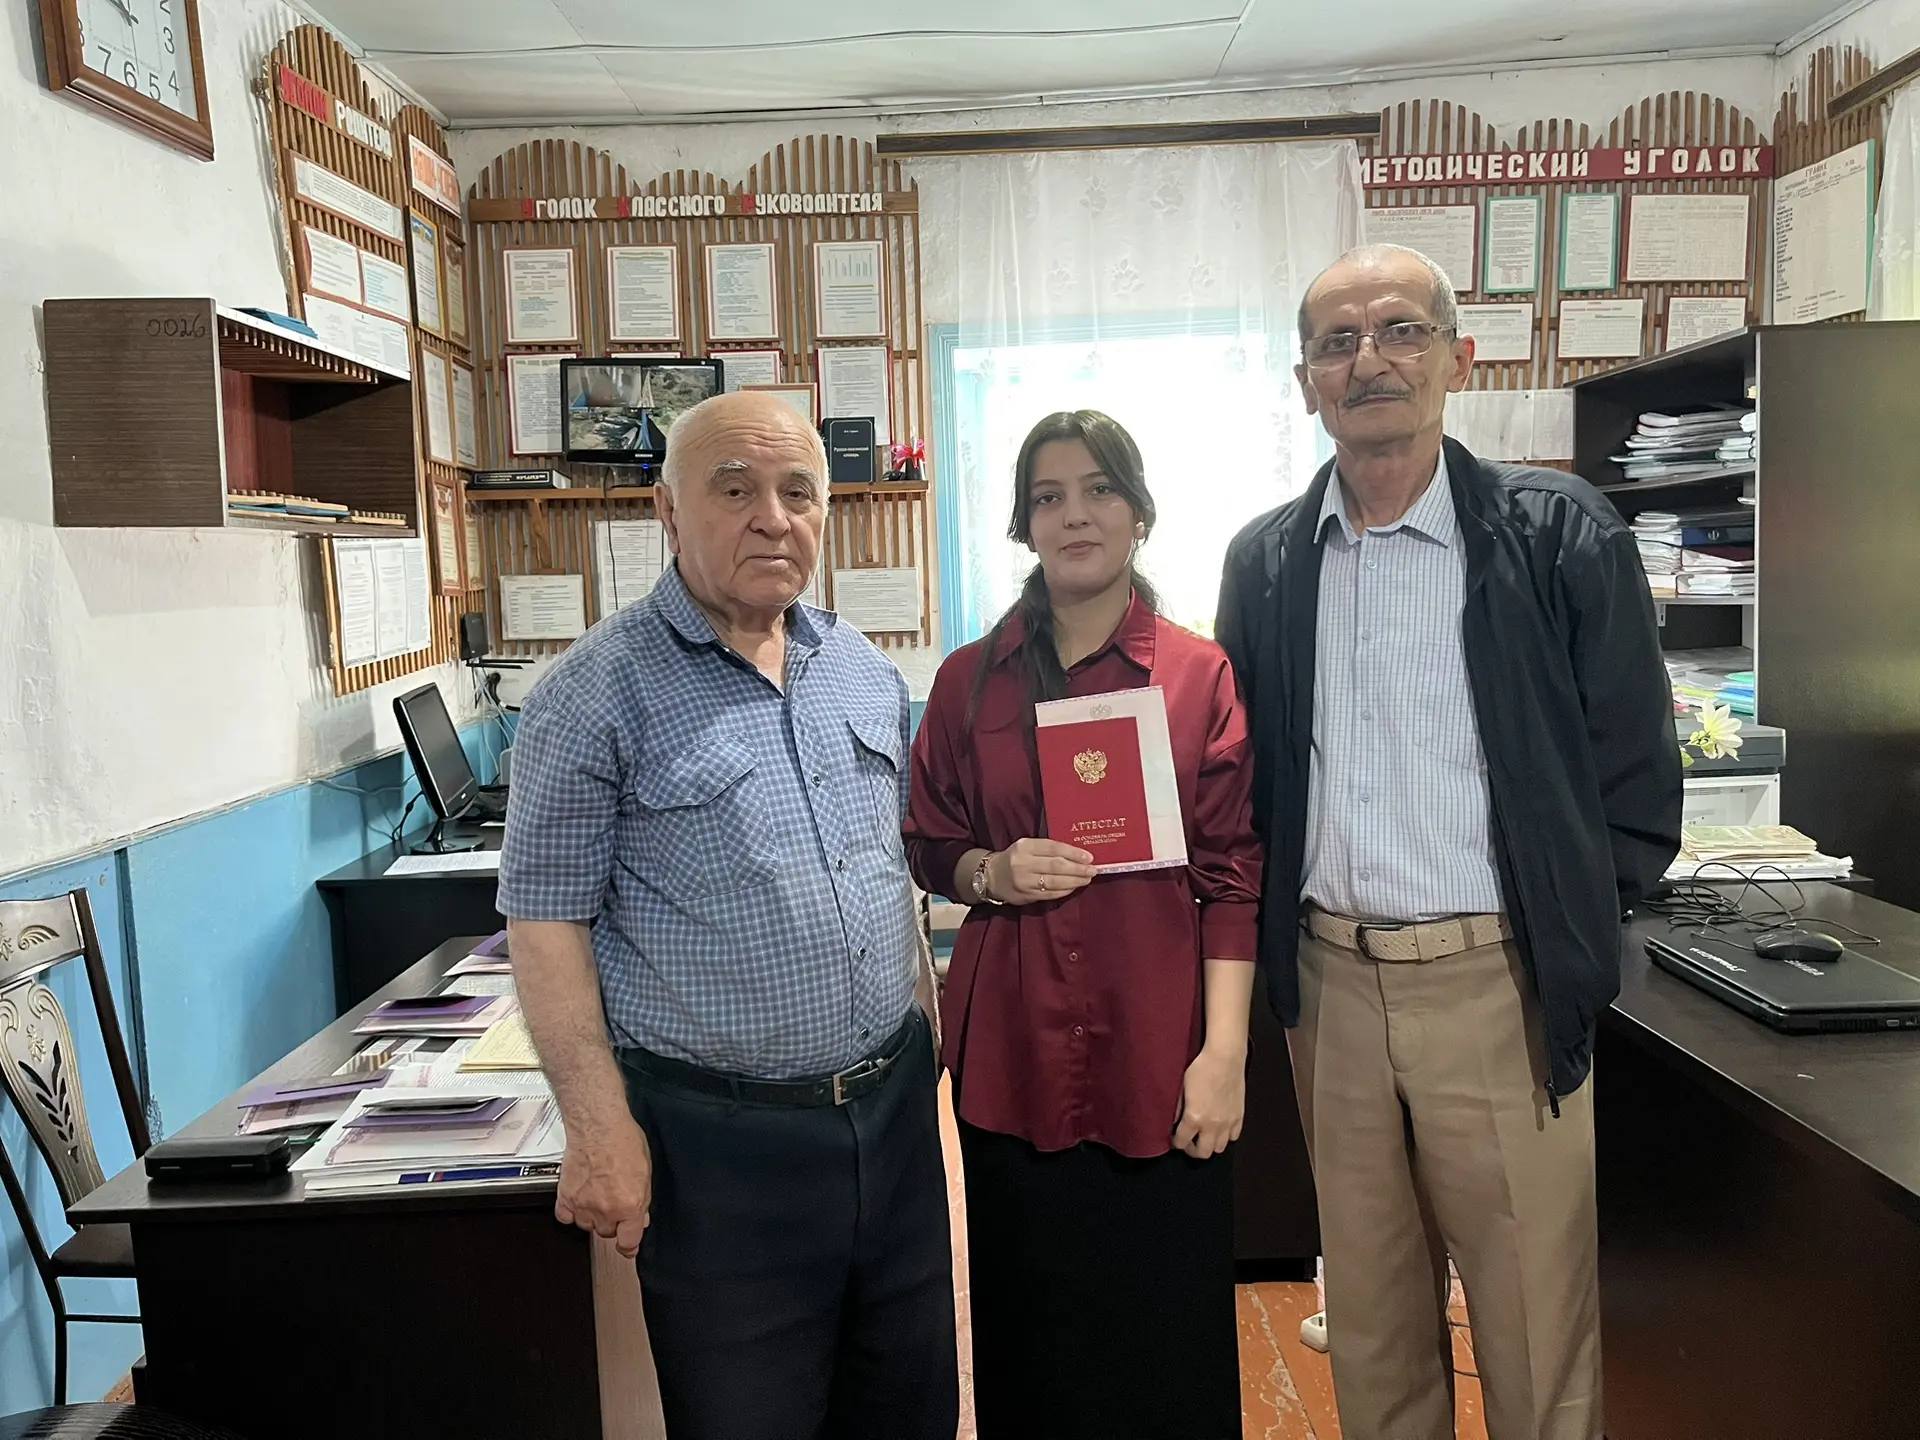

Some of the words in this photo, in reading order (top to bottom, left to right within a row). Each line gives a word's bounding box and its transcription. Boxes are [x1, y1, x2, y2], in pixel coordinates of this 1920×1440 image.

[163, 26, 175, 54] 3
[97, 45, 112, 75] 7
[123, 60, 138, 90] 6
[149, 72, 161, 100] 5
[168, 70, 180, 96] 4
[1358, 148, 1588, 184] МЕТОДИЧЕСКИЙ
[1623, 147, 1762, 175] УГОЛОК
[523, 197, 598, 219] УГОЛОК
[617, 194, 726, 218] КЛАССНОГО
[741, 192, 883, 215] РУКОВОДИТЕЛЯ
[147, 314, 206, 338] 0026
[1071, 817, 1126, 831] АТТЕСТАТ
